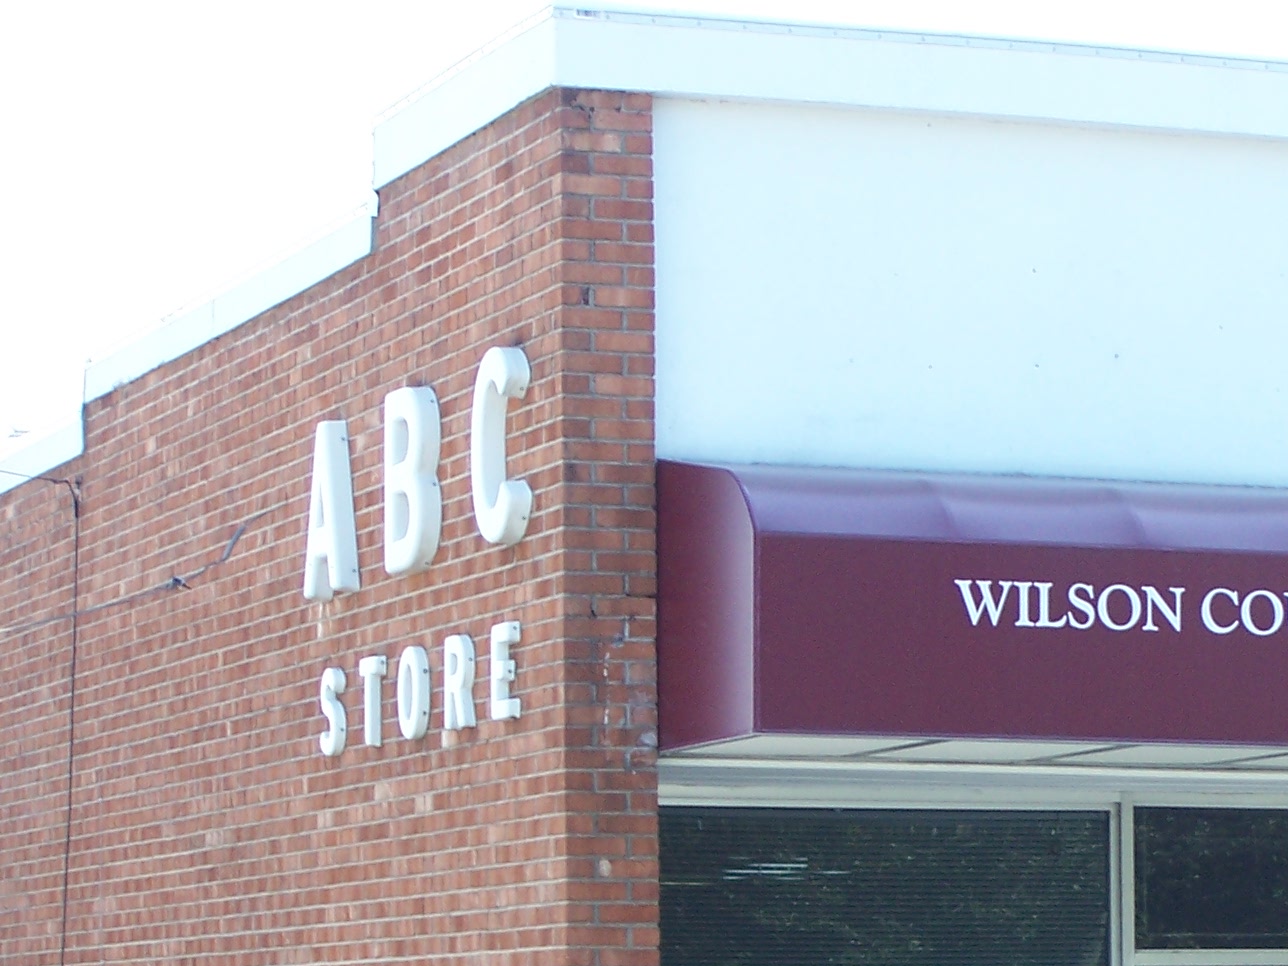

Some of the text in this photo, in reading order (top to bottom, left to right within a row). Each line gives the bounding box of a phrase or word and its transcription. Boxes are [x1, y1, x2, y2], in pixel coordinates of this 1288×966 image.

[303, 346, 533, 601] ABC
[954, 579, 1186, 633] WILSON
[319, 621, 521, 757] STORE
